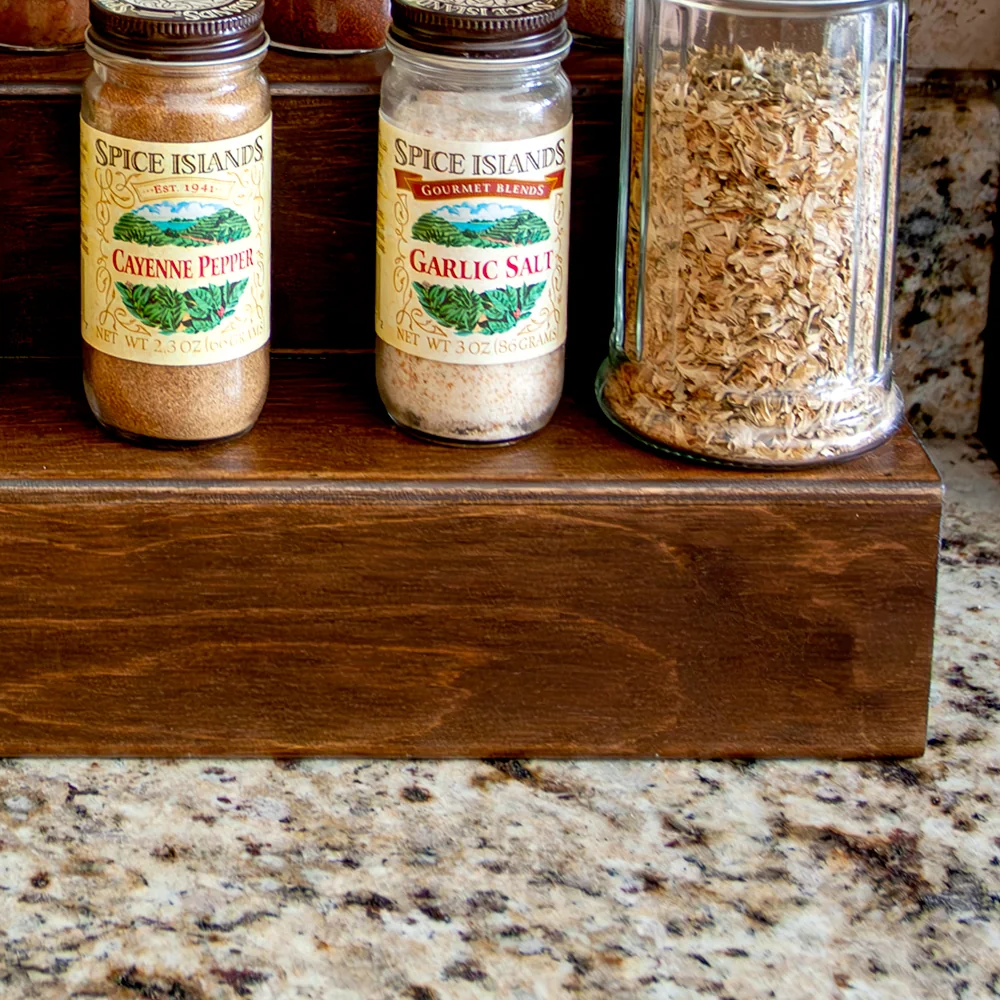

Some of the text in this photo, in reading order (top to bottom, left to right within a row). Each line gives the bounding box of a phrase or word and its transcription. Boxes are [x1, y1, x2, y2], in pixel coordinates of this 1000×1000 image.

[94, 135, 263, 174] SPICE ISLANDS
[394, 138, 565, 175] SPICE ISLANDS
[154, 183, 214, 193] EST. 1941
[421, 183, 545, 197] GOURMET BLENDS
[112, 248, 254, 279] CAYENNE PEPPER
[410, 249, 554, 280] GARLIC SALT
[96, 326, 117, 344] NET
[124, 335, 148, 351] WT
[180, 337, 201, 352] OZ
[396, 327, 420, 346] NET
[426, 336, 451, 352] WT
[455, 339, 465, 353] 3
[468, 340, 491, 354] OZ
